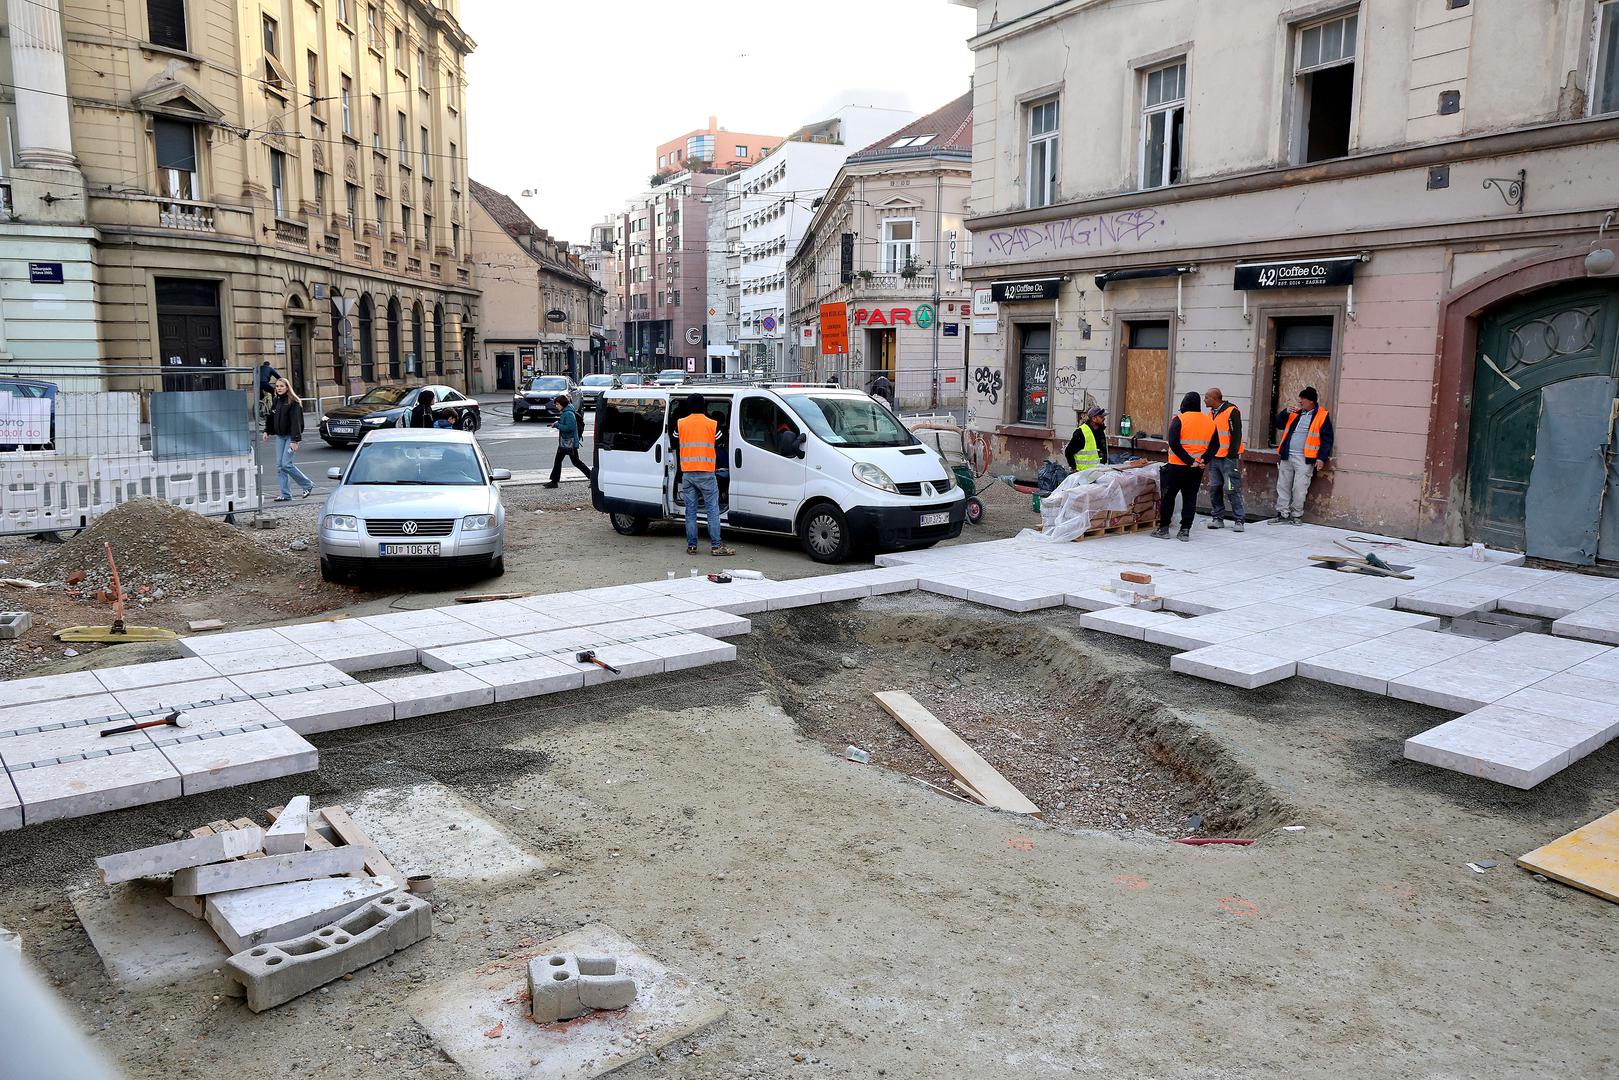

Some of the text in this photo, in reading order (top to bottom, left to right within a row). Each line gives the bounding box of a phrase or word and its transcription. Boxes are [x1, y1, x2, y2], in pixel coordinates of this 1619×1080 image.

[949, 231, 957, 280] HOTEL
[1258, 265, 1327, 286] 42 Coffee Co.
[1004, 285, 1015, 299] 42
[1016, 284, 1034, 293] Coffee
[387, 545, 439, 555] DU 106-KE
